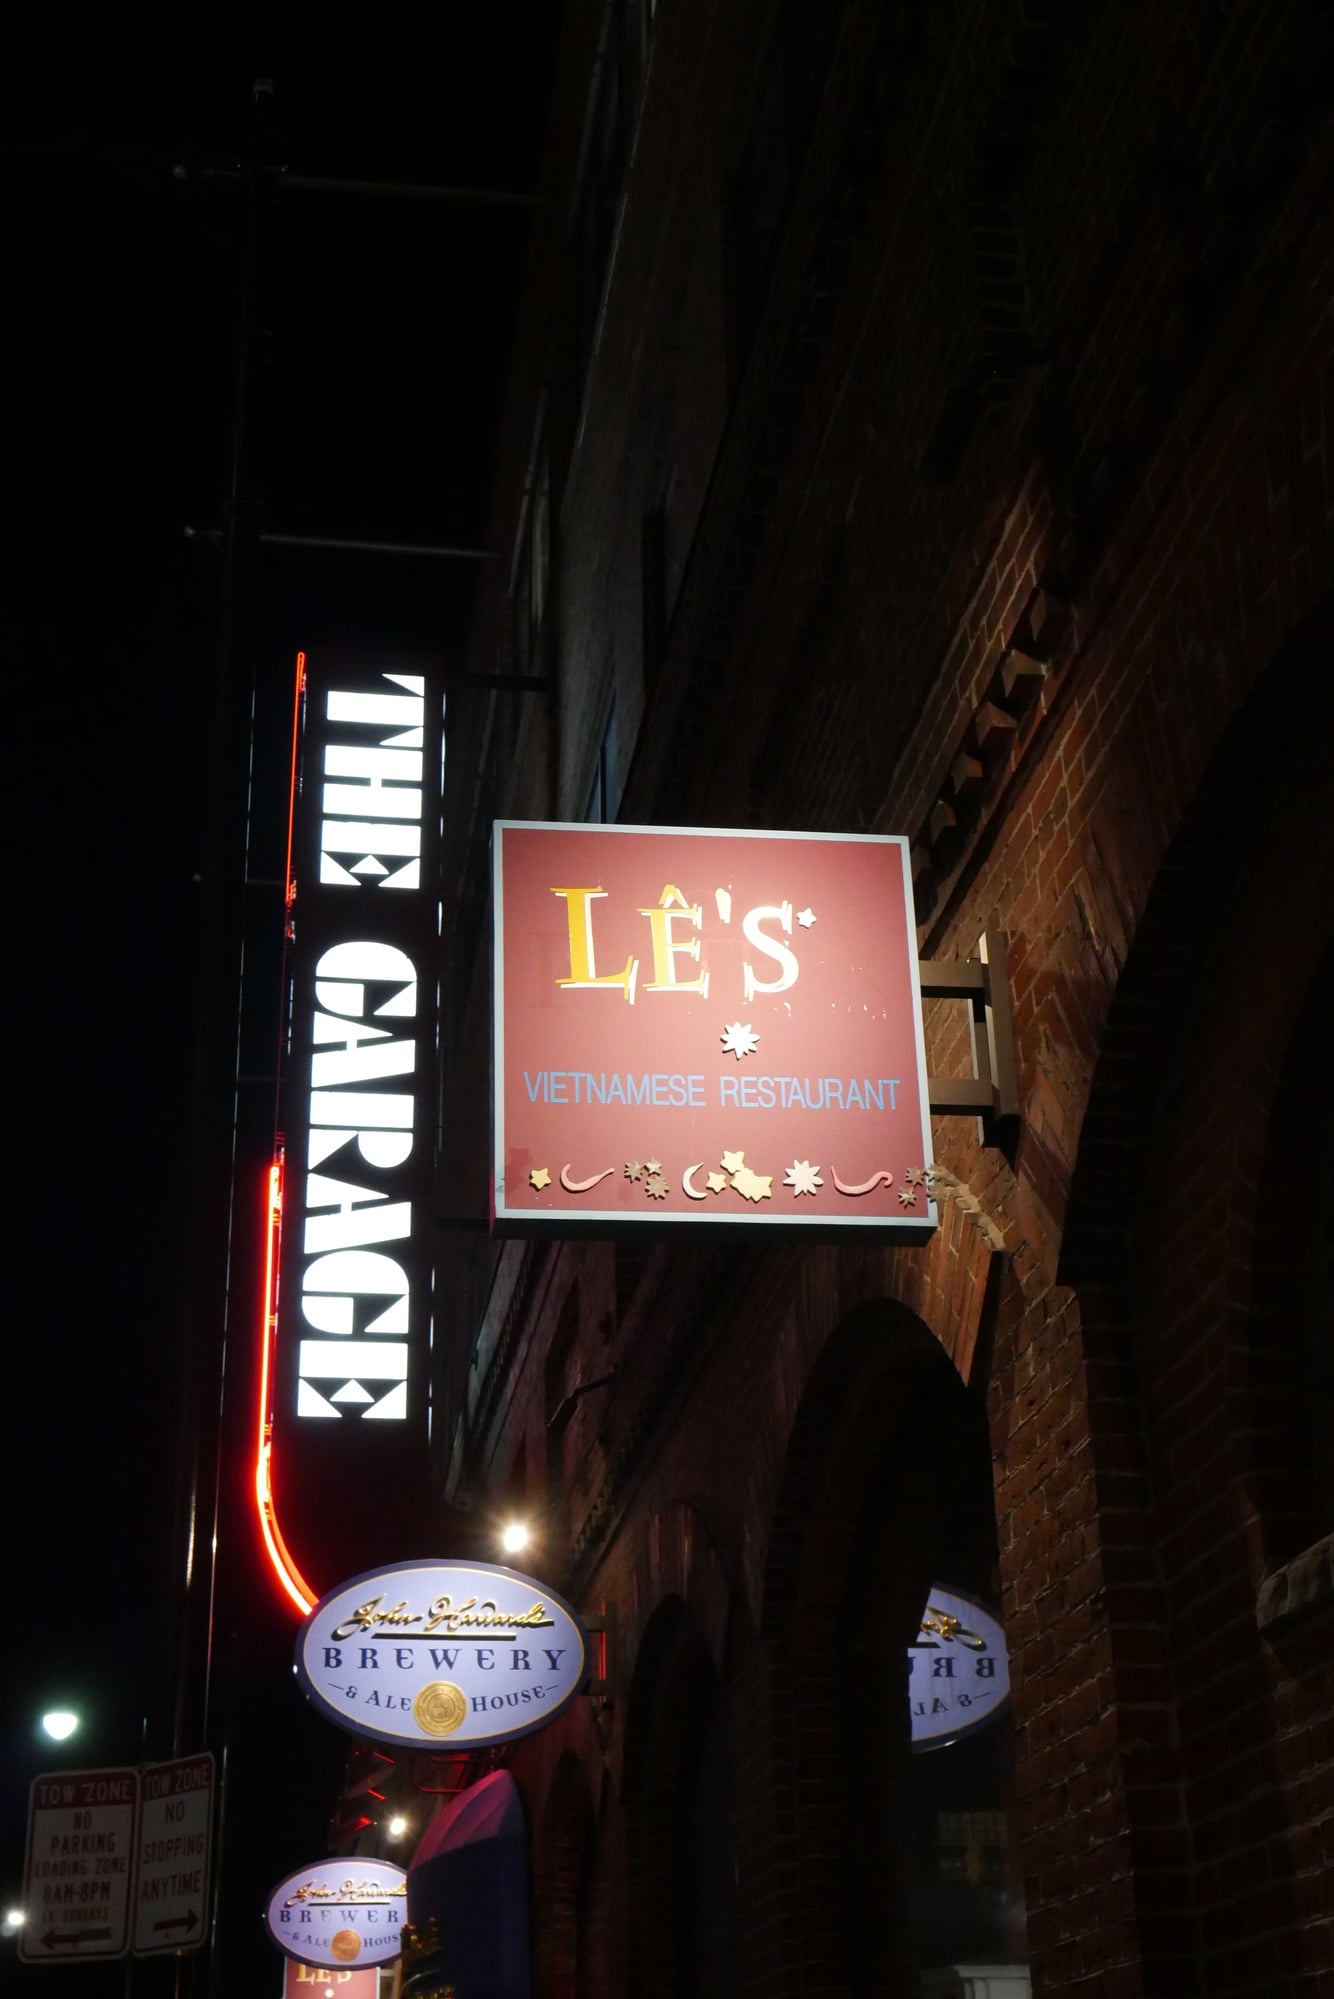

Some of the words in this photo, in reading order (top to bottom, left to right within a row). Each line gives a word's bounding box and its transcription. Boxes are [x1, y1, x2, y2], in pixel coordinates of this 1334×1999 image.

[319, 673, 426, 890] THE
[523, 1071, 706, 1106] VIETNAMESE
[721, 1076, 900, 1111] RESTAURANT
[297, 940, 419, 1421] GARAGE
[331, 1594, 424, 1642] John
[323, 1647, 566, 1671] BREWERY
[345, 1685, 357, 1699] &
[366, 1689, 412, 1712] ALE
[471, 1685, 546, 1713] HOUSE
[40, 1785, 74, 1804] TOW
[81, 1779, 132, 1803] ZONE
[145, 1775, 171, 1800] TOW
[175, 1763, 209, 1793] ZONE
[73, 1811, 92, 1830] NO
[165, 1801, 185, 1824] NO
[51, 1832, 115, 1854] PARKING
[143, 1834, 204, 1865] STOPPING
[35, 1860, 87, 1878] LOADING
[95, 1856, 127, 1874] ZONE
[142, 1870, 202, 1902] ANYTIME
[279, 1909, 399, 1923] BREWER
